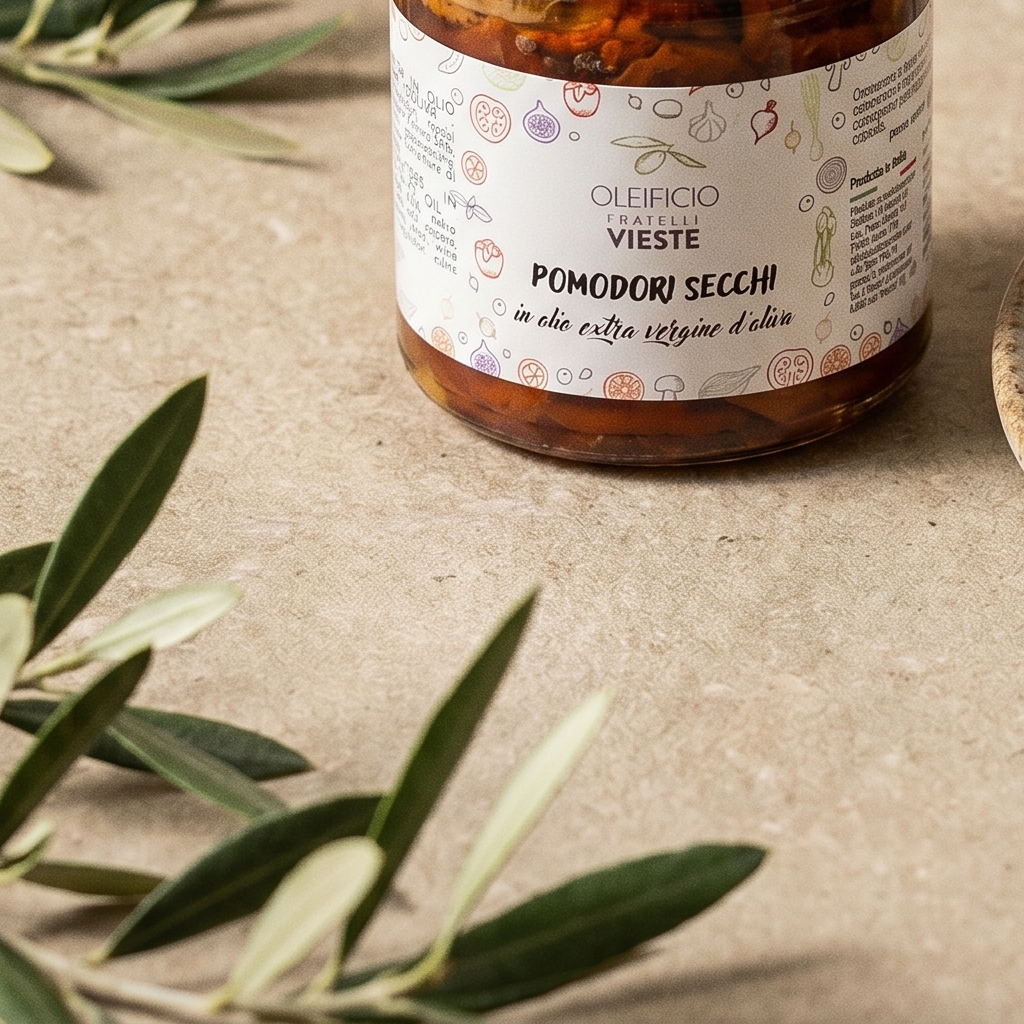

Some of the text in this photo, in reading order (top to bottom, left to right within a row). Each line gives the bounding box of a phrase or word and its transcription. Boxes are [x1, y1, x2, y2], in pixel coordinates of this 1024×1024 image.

[427, 90, 455, 116] OLIO
[424, 193, 442, 215] OIL
[590, 184, 720, 208] OLEIFICIO
[606, 213, 699, 226] FRATELLI
[606, 227, 700, 250] VIESTE
[530, 262, 778, 305] POMODORI SECCHI
[513, 303, 534, 323] in
[578, 313, 639, 346] extra
[642, 319, 724, 347] vergine
[728, 304, 797, 336] d'oliva
